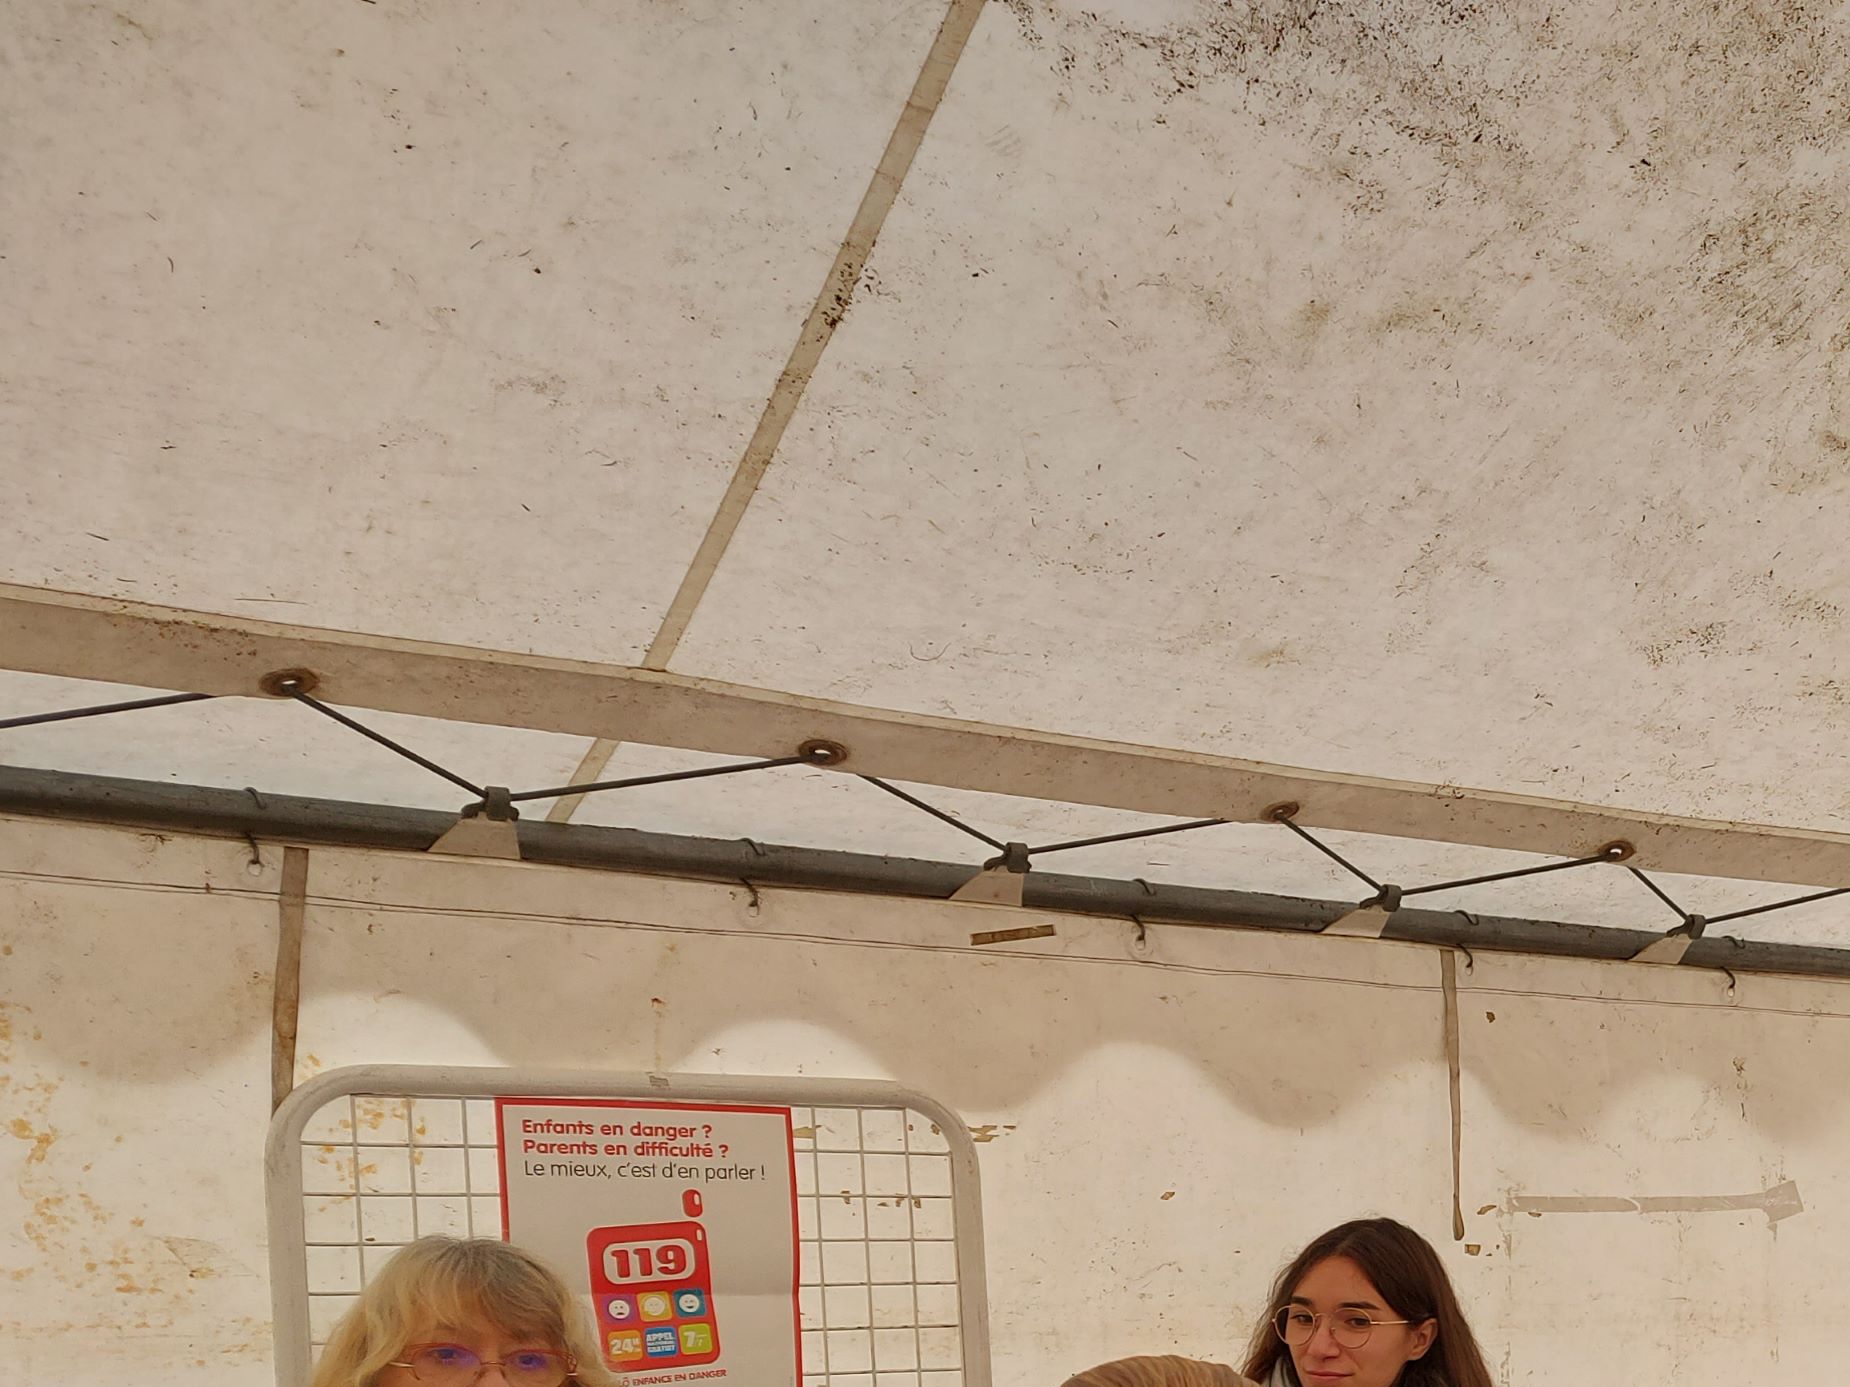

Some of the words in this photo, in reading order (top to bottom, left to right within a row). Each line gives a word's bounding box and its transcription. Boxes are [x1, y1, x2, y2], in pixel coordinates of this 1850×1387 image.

[522, 1119, 594, 1135] Enfants
[600, 1123, 623, 1136] en
[630, 1122, 696, 1141] danger
[702, 1124, 712, 1138] ?
[523, 1139, 598, 1155] Parents
[604, 1142, 627, 1155] en
[634, 1141, 713, 1158] difficulté
[719, 1144, 729, 1158] ?
[524, 1160, 545, 1176] Le
[551, 1160, 612, 1180] mieux,
[617, 1162, 656, 1178] c'est
[662, 1161, 699, 1179] d'en
[705, 1163, 755, 1183] parler
[610, 1245, 687, 1278] 119
[633, 1375, 672, 1386] ENFANCE
[674, 1373, 686, 1381] EN
[689, 1369, 727, 1380] DANGER
